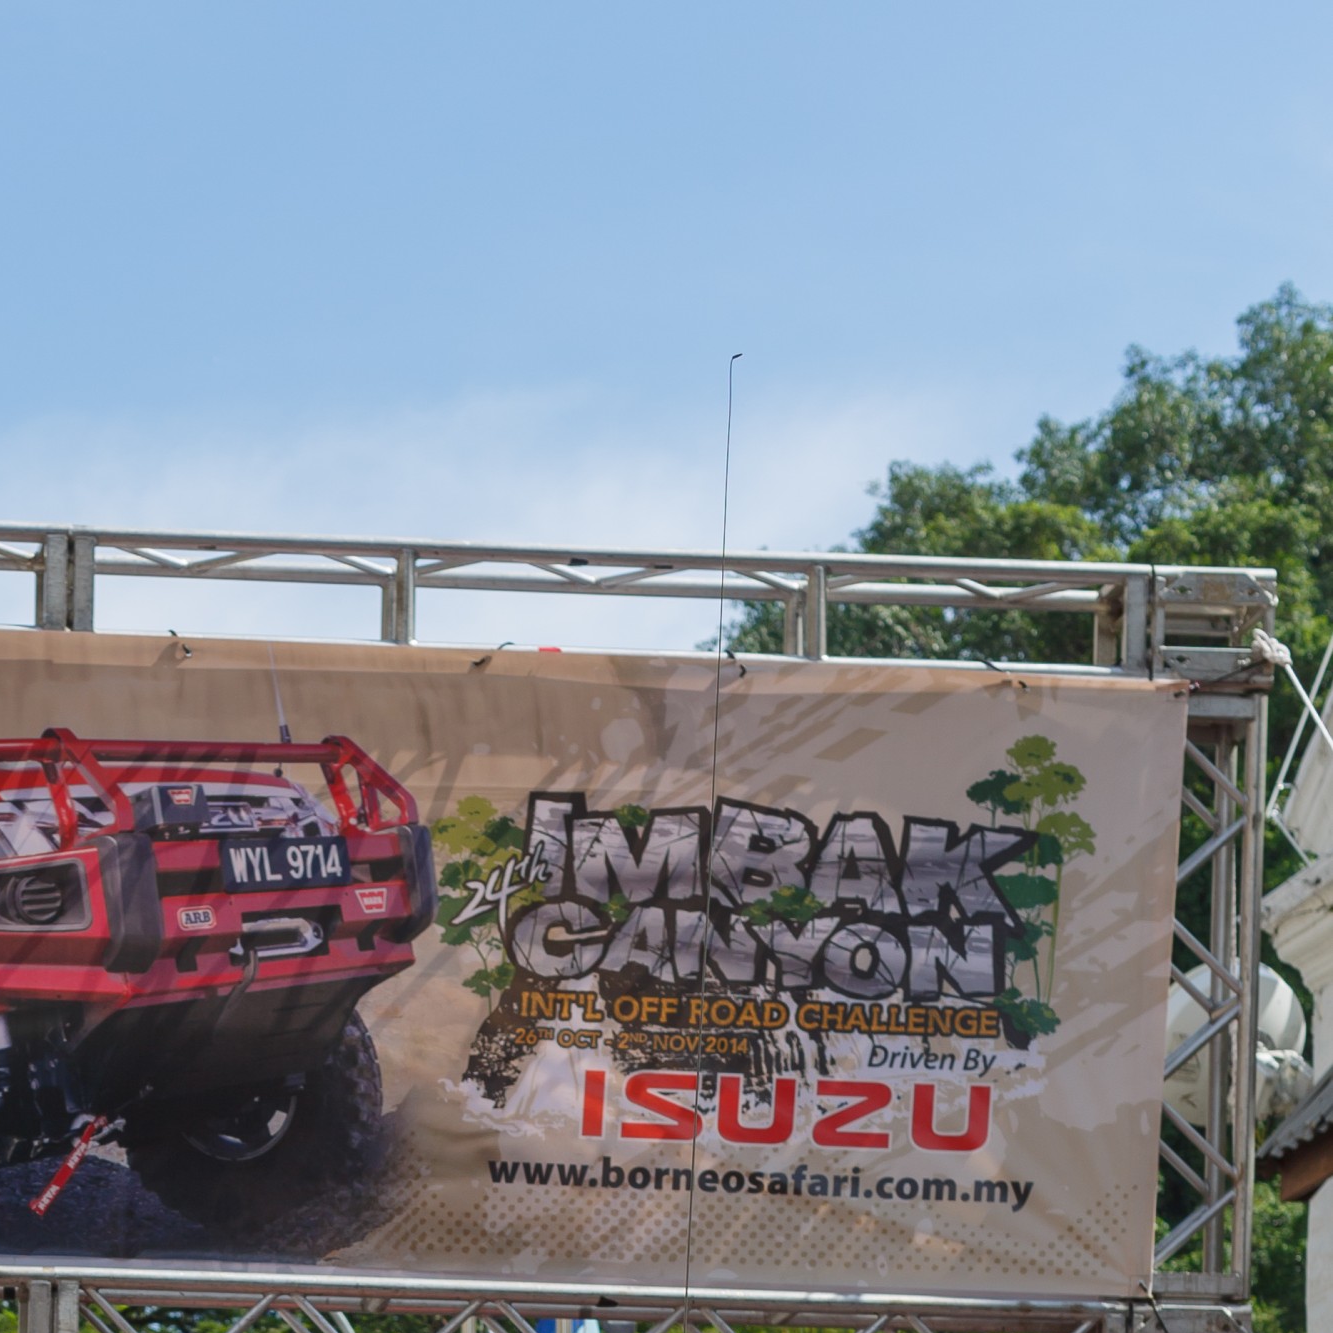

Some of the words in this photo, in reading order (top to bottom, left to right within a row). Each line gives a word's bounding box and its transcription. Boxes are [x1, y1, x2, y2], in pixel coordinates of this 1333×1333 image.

[229, 847, 282, 883] WYL
[286, 844, 343, 880] 9714
[523, 791, 1042, 932] IMBAK
[450, 839, 551, 940] 24th
[183, 909, 212, 926] ARB
[505, 897, 1015, 1000] CANYON
[520, 990, 603, 1022] INT'L
[613, 995, 679, 1023] OFF
[688, 998, 787, 1031] ROAD
[797, 1002, 1000, 1039] CHALLENGE
[557, 1029, 603, 1048] OCT
[652, 1034, 701, 1053] NOV
[704, 1035, 749, 1055] 2014
[869, 1043, 954, 1071] Driven
[963, 1048, 996, 1079] By
[580, 1069, 993, 1152] ISUZU
[487, 1155, 1035, 1213] www.borneosafari.com.my
